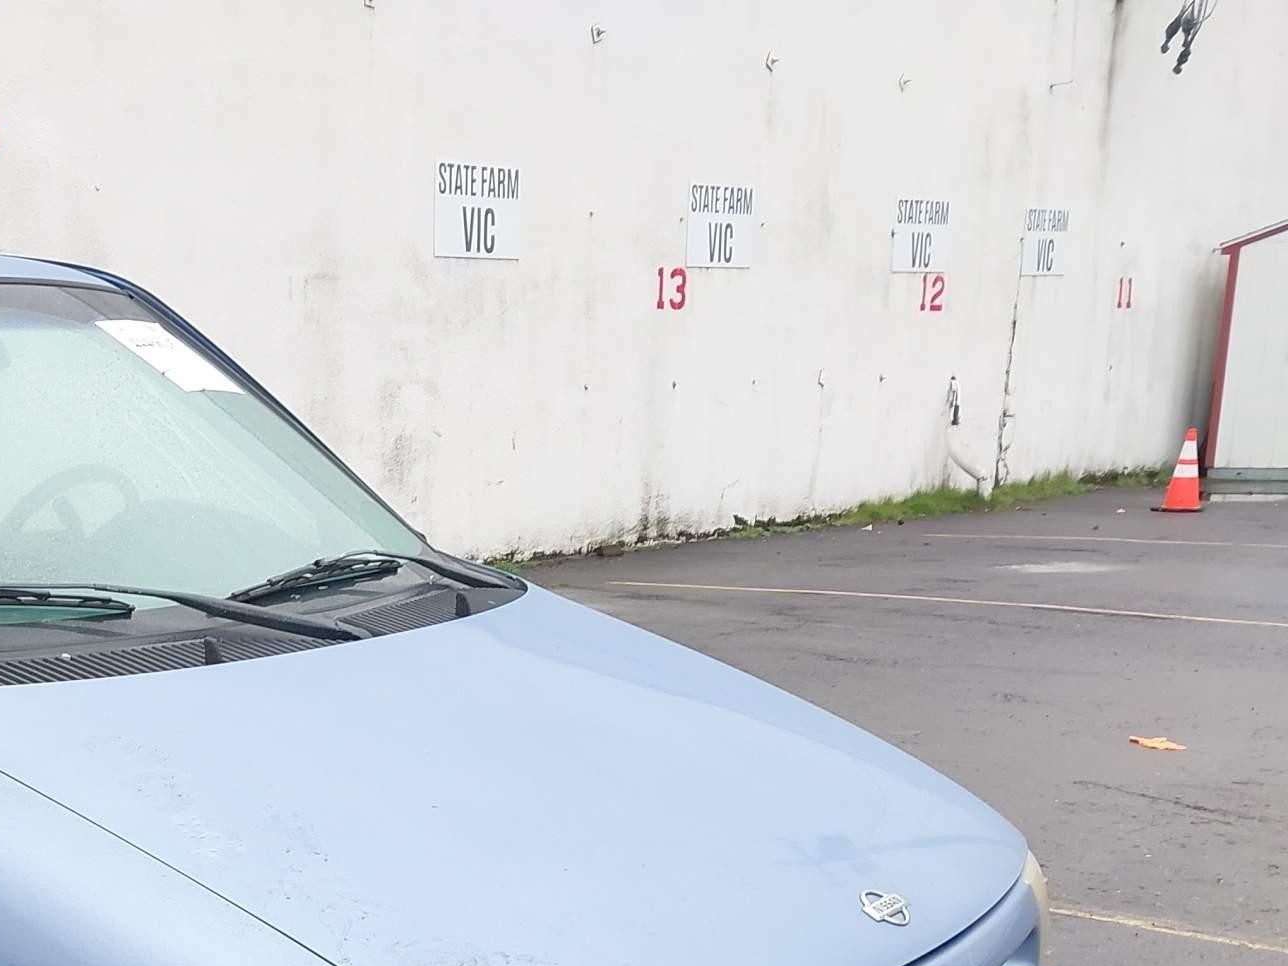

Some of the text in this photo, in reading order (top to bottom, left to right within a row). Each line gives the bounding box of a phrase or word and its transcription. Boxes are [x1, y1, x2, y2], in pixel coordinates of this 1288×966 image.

[438, 162, 519, 200] STATE FARM
[691, 184, 753, 215] STATE FARM
[462, 206, 495, 253] VIC
[897, 199, 949, 225] STATE FARM
[1027, 208, 1069, 232] STATE FARM
[708, 222, 733, 263] VIC
[911, 231, 932, 268] VIC
[1037, 239, 1054, 272] VIC
[656, 266, 687, 310] 13
[920, 272, 945, 311] 12
[1117, 277, 1132, 308] 11
